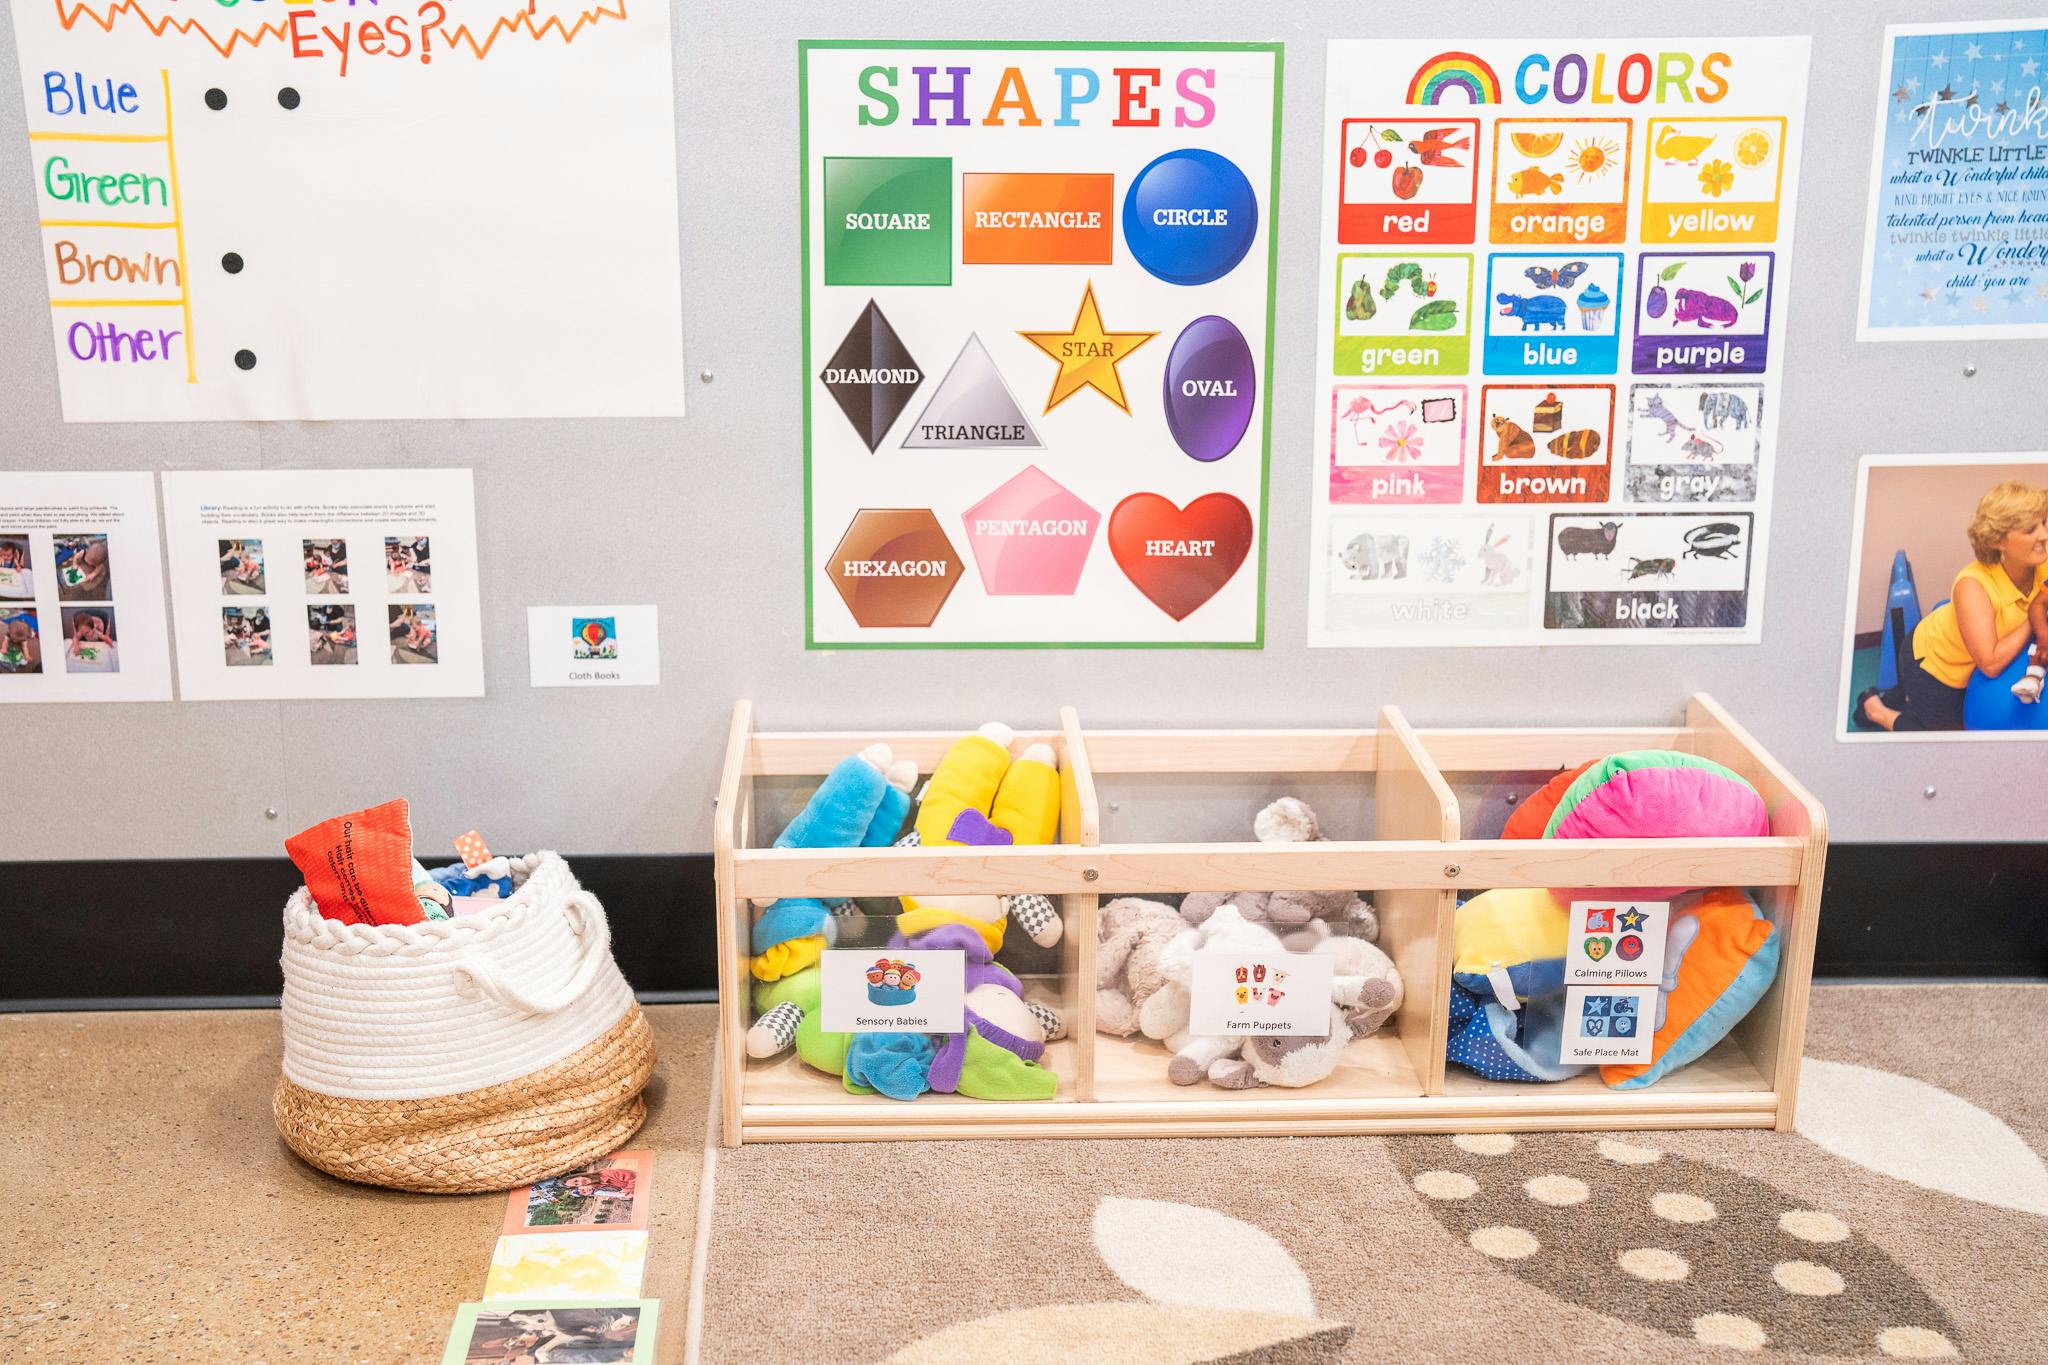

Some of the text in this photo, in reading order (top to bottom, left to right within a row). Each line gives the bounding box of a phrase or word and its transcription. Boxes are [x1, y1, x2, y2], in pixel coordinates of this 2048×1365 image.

[288, 1, 446, 77] Eyes?
[1514, 52, 1732, 105] COLORS
[43, 71, 139, 114] Blue
[858, 65, 1216, 128] SHAPES
[1908, 145, 2048, 165] TWINKLE LITTLE
[44, 156, 167, 206] Green
[1889, 169, 1923, 184] what
[1923, 174, 1933, 183] a
[1936, 166, 2019, 187] Wonderful
[1894, 193, 1918, 206] KIND
[845, 213, 931, 230] SQUARE
[975, 211, 1101, 229] RECTANGLE
[1152, 208, 1228, 226] CIRCLE
[1382, 210, 1430, 234] red
[1668, 209, 1754, 232] yellow
[1886, 212, 1939, 227] talented
[1936, 213, 1981, 231] person
[1983, 210, 2015, 229] from
[1510, 215, 1605, 240] orange
[1890, 231, 1947, 244] twinkle
[1952, 229, 2010, 243] twinkle
[54, 240, 181, 286] Brown
[1916, 250, 1945, 262] what
[1946, 253, 1954, 262] a
[1946, 275, 2030, 292] child you are
[67, 321, 182, 363] Other
[1061, 341, 1115, 358] STAR
[1361, 347, 1439, 371] green
[1523, 343, 1577, 365] blue
[1656, 341, 1745, 368] purple
[825, 368, 920, 385] DIAMOND
[1182, 380, 1237, 398] OVAL
[922, 424, 1025, 441] TRIANGLE
[1371, 473, 1425, 498] pink
[1499, 473, 1587, 495] brown
[1660, 474, 1720, 499] gray
[975, 519, 1088, 537] PENTAGON
[1145, 540, 1215, 557] HEART
[843, 560, 947, 577] HEXAGON
[1392, 598, 1468, 621] white
[1615, 599, 1679, 621] black
[568, 671, 620, 680] Cloth Books
[344, 821, 353, 838] Our
[345, 840, 354, 860] hair
[328, 850, 341, 880] colors
[340, 882, 349, 902] and
[336, 845, 356, 902] Hair comes
[348, 862, 356, 882] can
[354, 883, 363, 896] be
[1574, 969, 1648, 979] Calming Pillows
[856, 1017, 928, 1027] Sensory Babies
[1226, 1020, 1292, 1031] Farm Puppets
[1573, 1048, 1639, 1057] Safe Place Mat
